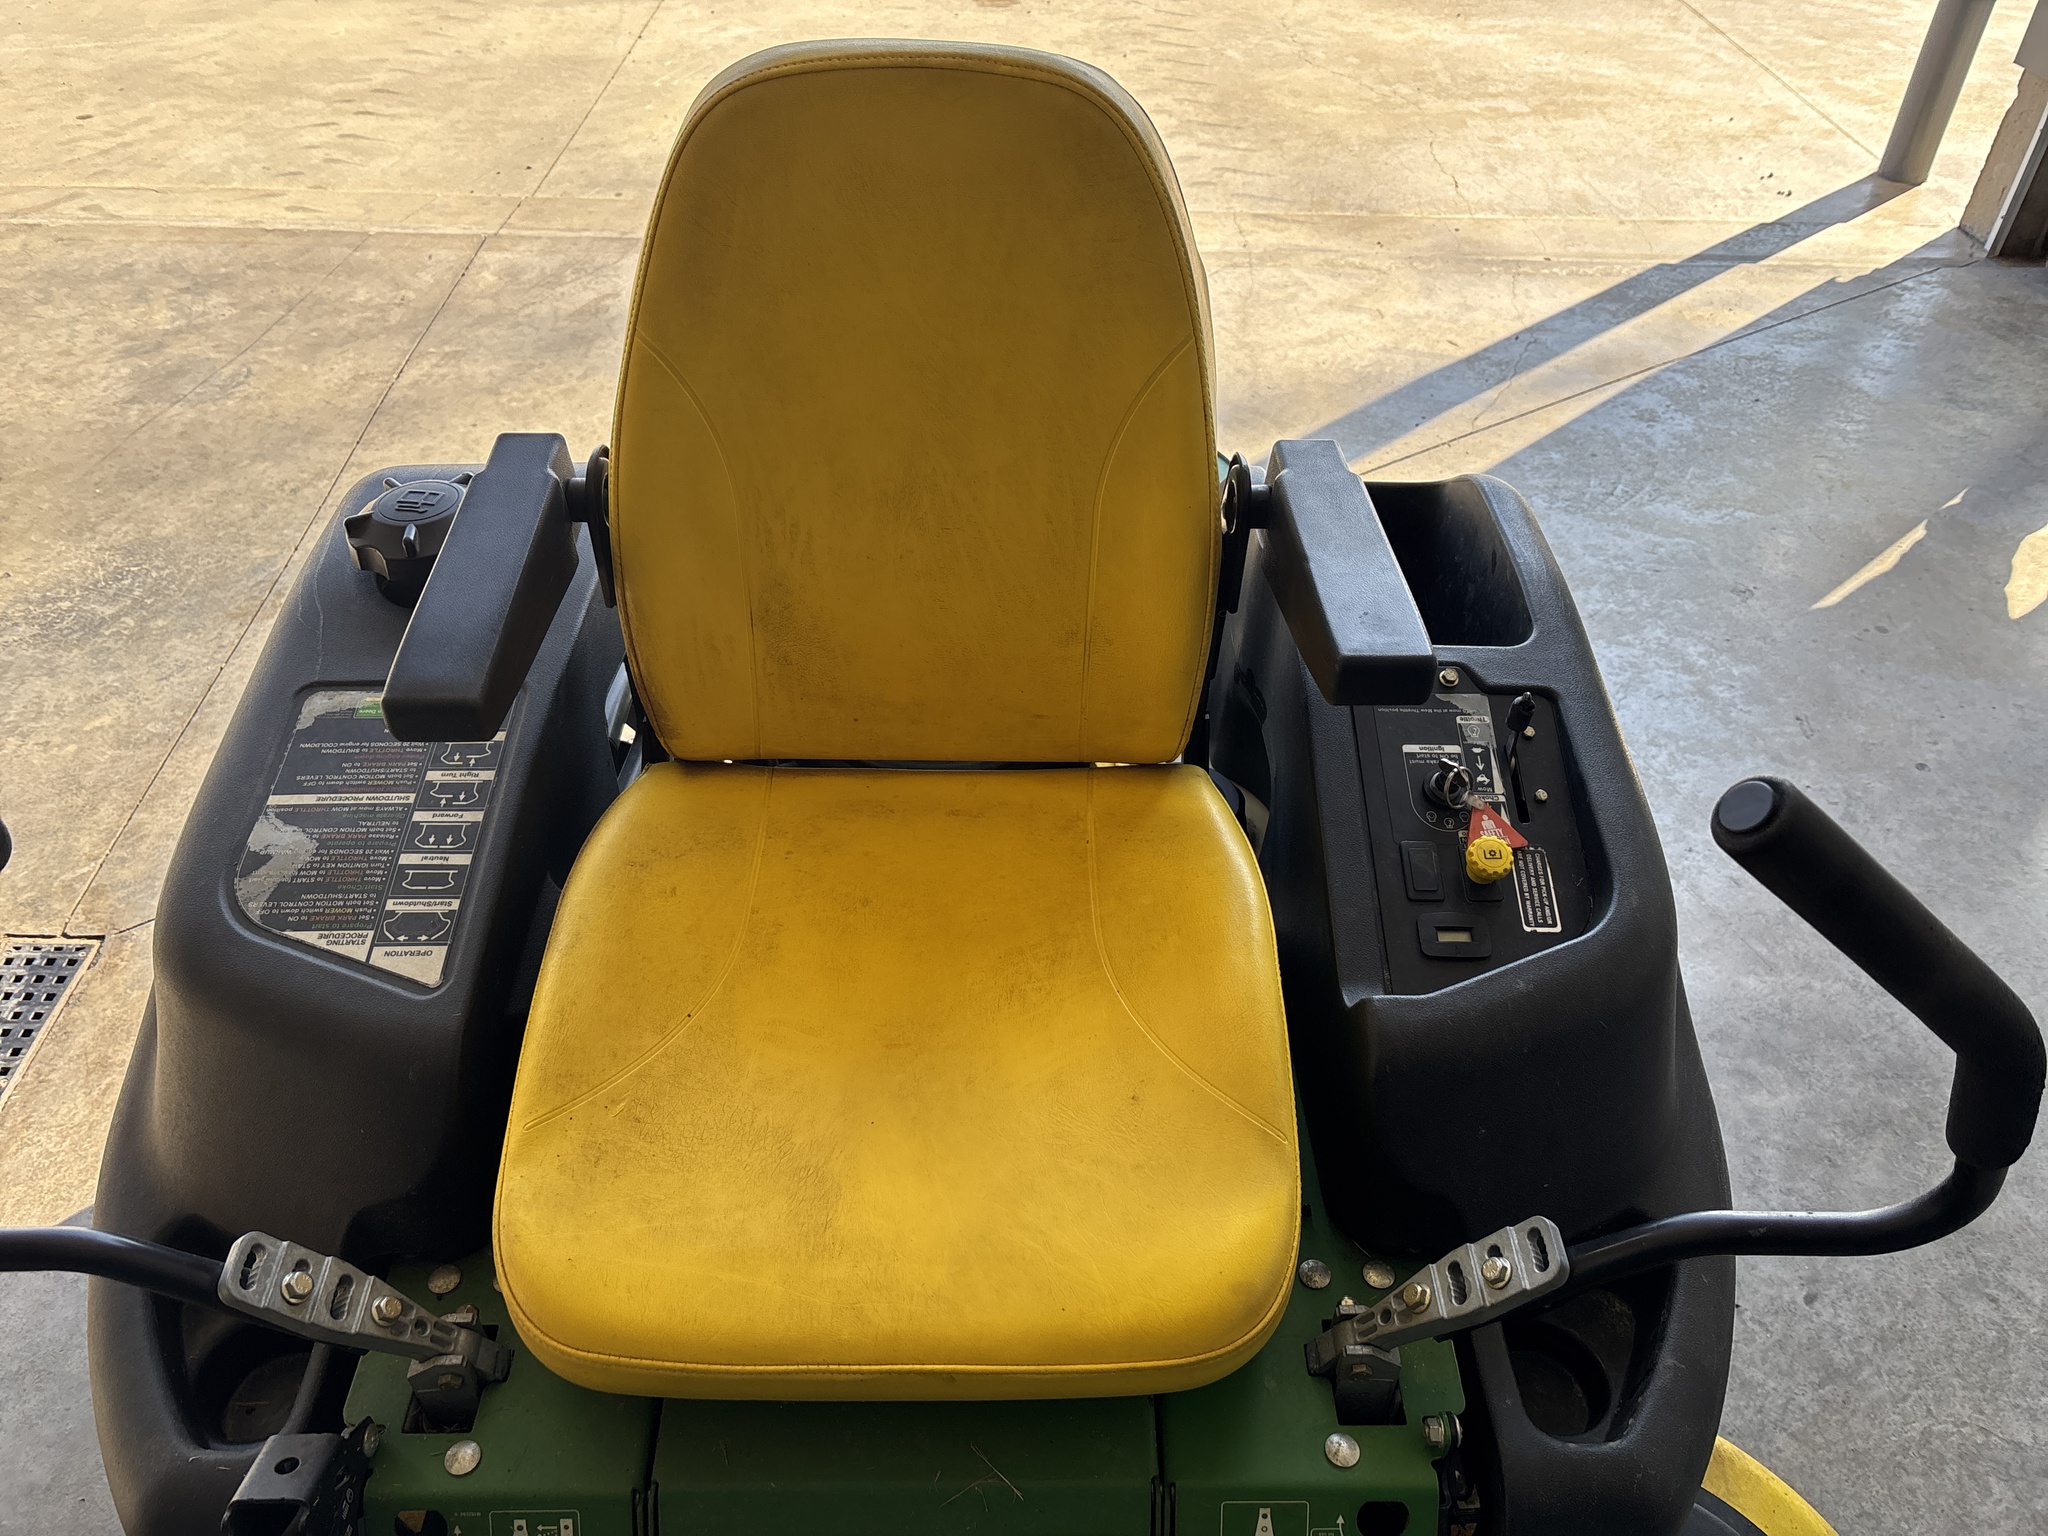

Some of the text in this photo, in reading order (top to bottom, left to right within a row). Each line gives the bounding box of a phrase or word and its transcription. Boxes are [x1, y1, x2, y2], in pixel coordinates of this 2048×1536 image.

[1526, 854, 1535, 876] DELIVERY
[1535, 854, 1544, 874] CHARGES
[1520, 870, 1530, 892] COVERED
[1525, 900, 1535, 927] WARRANTY
[1532, 887, 1541, 907] SERVICE
[1540, 886, 1550, 905] PICK-UP
[1536, 907, 1544, 924] CALLS
[1544, 905, 1553, 924] AND/OR
